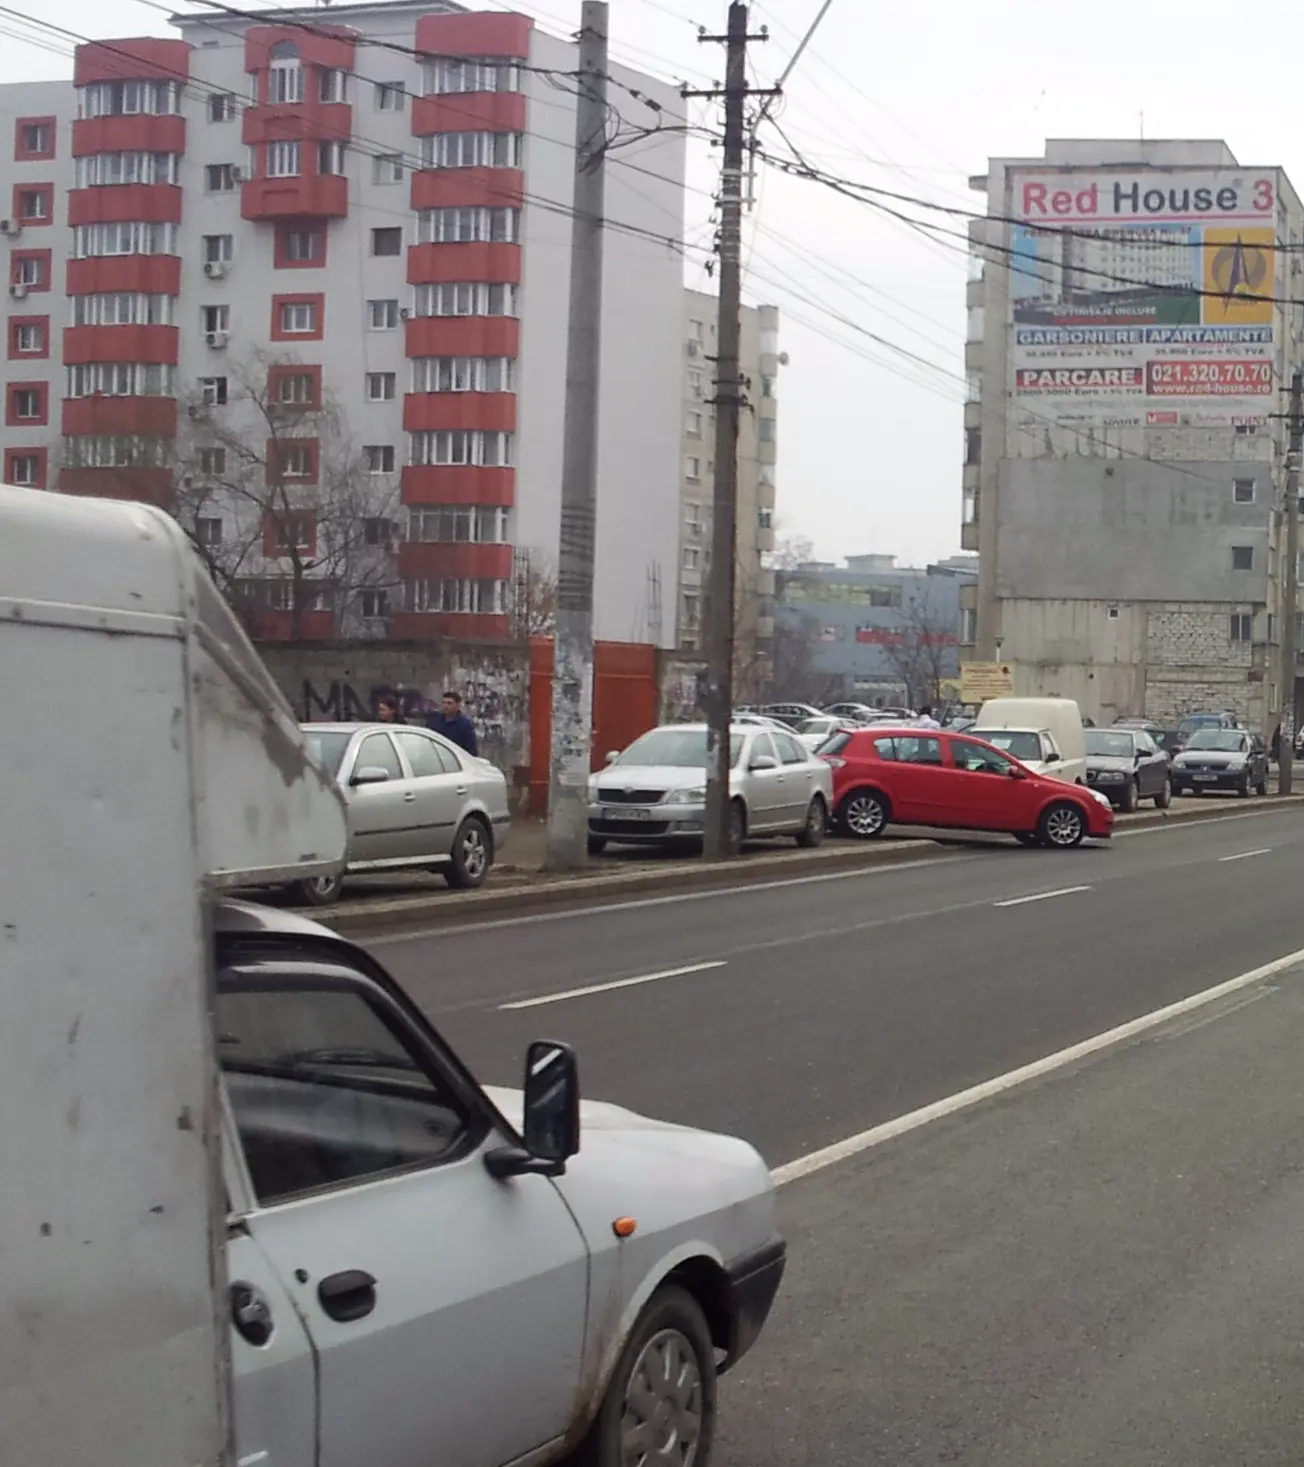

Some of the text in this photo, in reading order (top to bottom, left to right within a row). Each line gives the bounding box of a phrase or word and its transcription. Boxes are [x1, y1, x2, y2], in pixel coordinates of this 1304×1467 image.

[1023, 179, 1274, 215] Red House 3
[1020, 330, 1142, 345] GARSONIERE
[1152, 328, 1271, 343] APARTAMENTE
[1023, 369, 1136, 386] PARCARE
[1152, 364, 1271, 383] 021.320.70.70
[1152, 383, 1271, 394] www.red-house.ro
